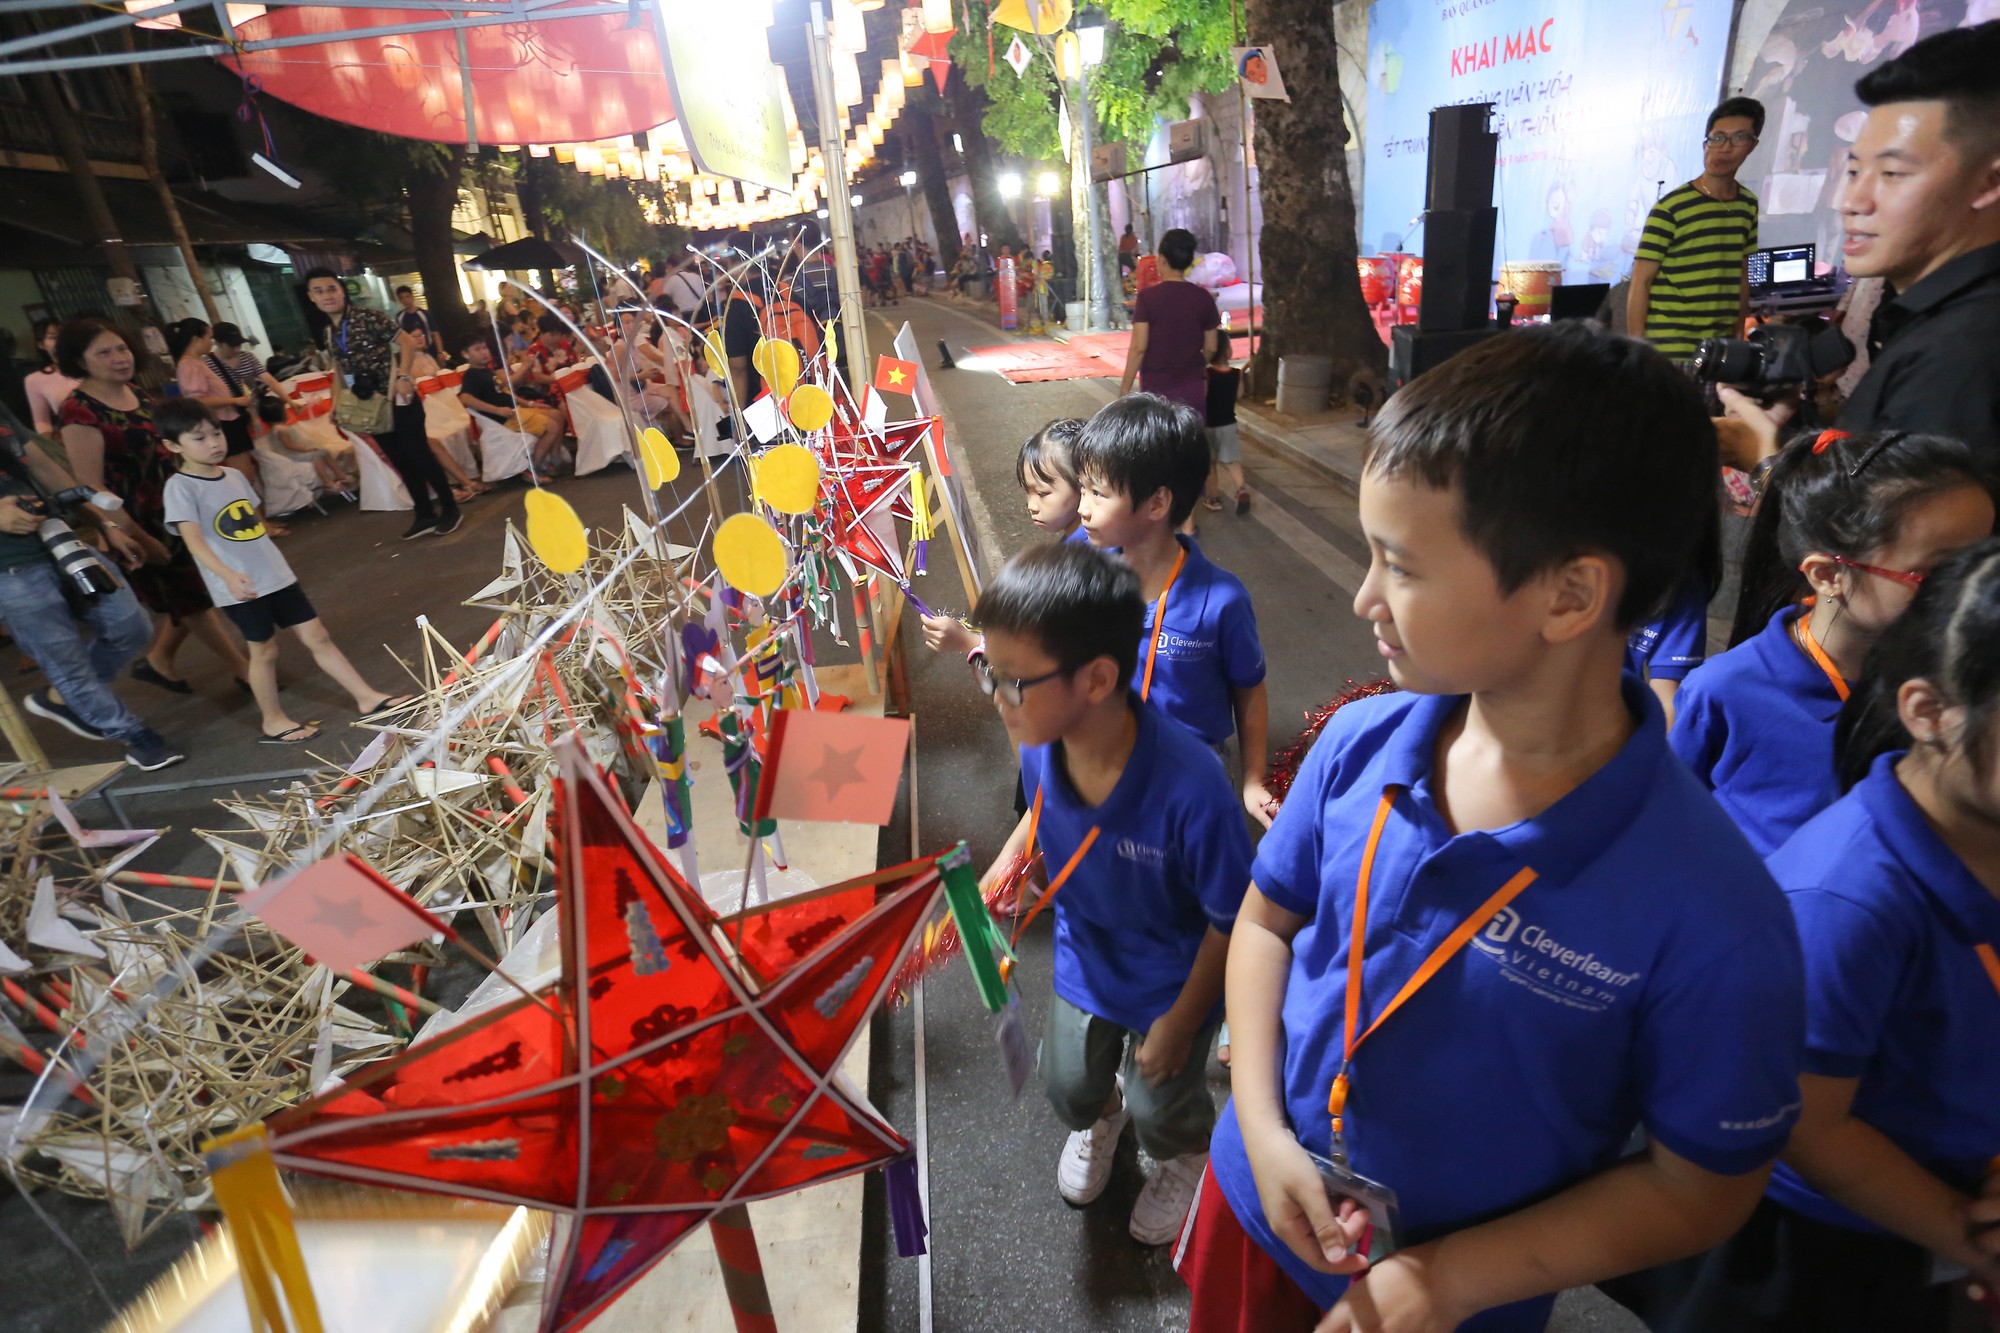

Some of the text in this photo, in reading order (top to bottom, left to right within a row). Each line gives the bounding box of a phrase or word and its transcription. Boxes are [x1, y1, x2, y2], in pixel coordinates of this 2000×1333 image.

[1451, 17, 1554, 78] KHAI MẠC
[1512, 950, 1617, 1004] Vietnam
[1520, 925, 1634, 986] Cleverlearn
